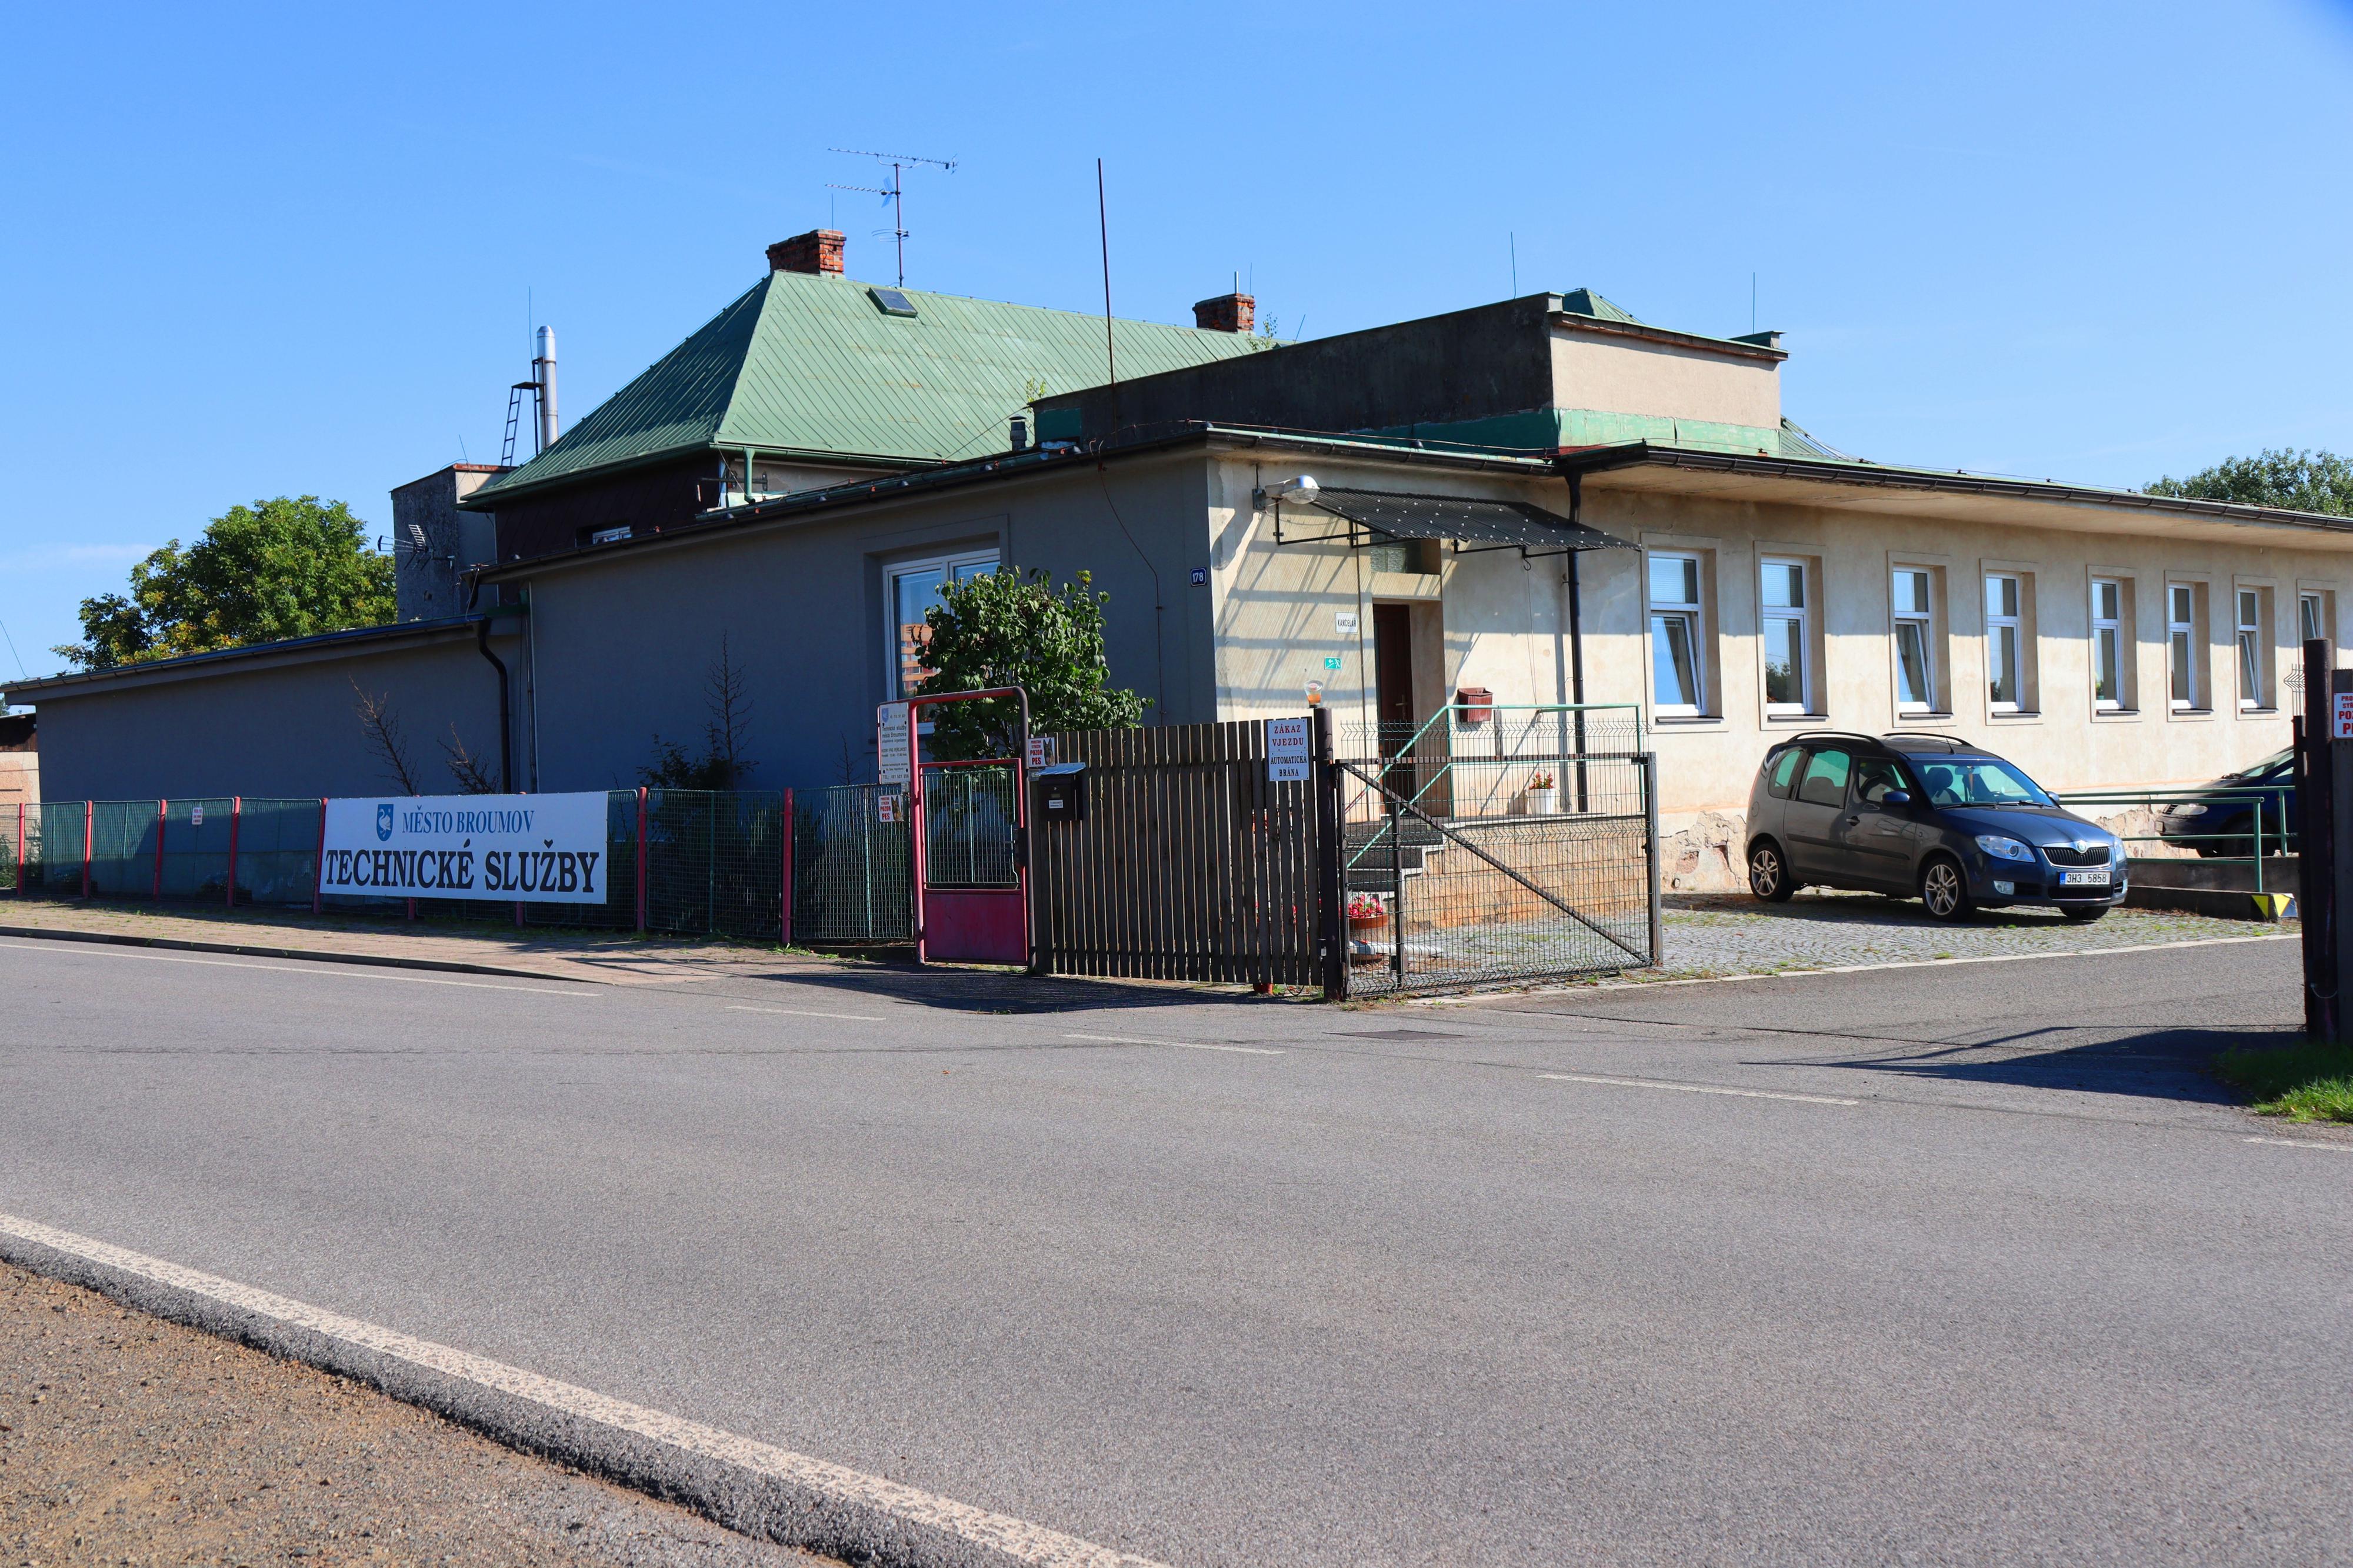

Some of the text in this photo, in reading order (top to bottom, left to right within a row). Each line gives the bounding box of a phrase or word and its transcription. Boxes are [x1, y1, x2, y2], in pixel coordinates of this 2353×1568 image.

[1193, 572, 1204, 583] 178
[2339, 711, 2353, 720] PO
[1274, 723, 1301, 734] ZÁKAZ
[2343, 723, 2353, 735] P
[1272, 738, 1304, 746] VJEZDU
[1032, 757, 1041, 765] PES
[1271, 753, 1307, 765] AUTOMATICKÁ
[1279, 767, 1299, 777] BRÁNA
[402, 804, 535, 833] MĚSTO BROUMOV
[325, 838, 599, 893] TECHNICKÉ SLUŽBY
[2067, 873, 2107, 883] 3H3 5858
